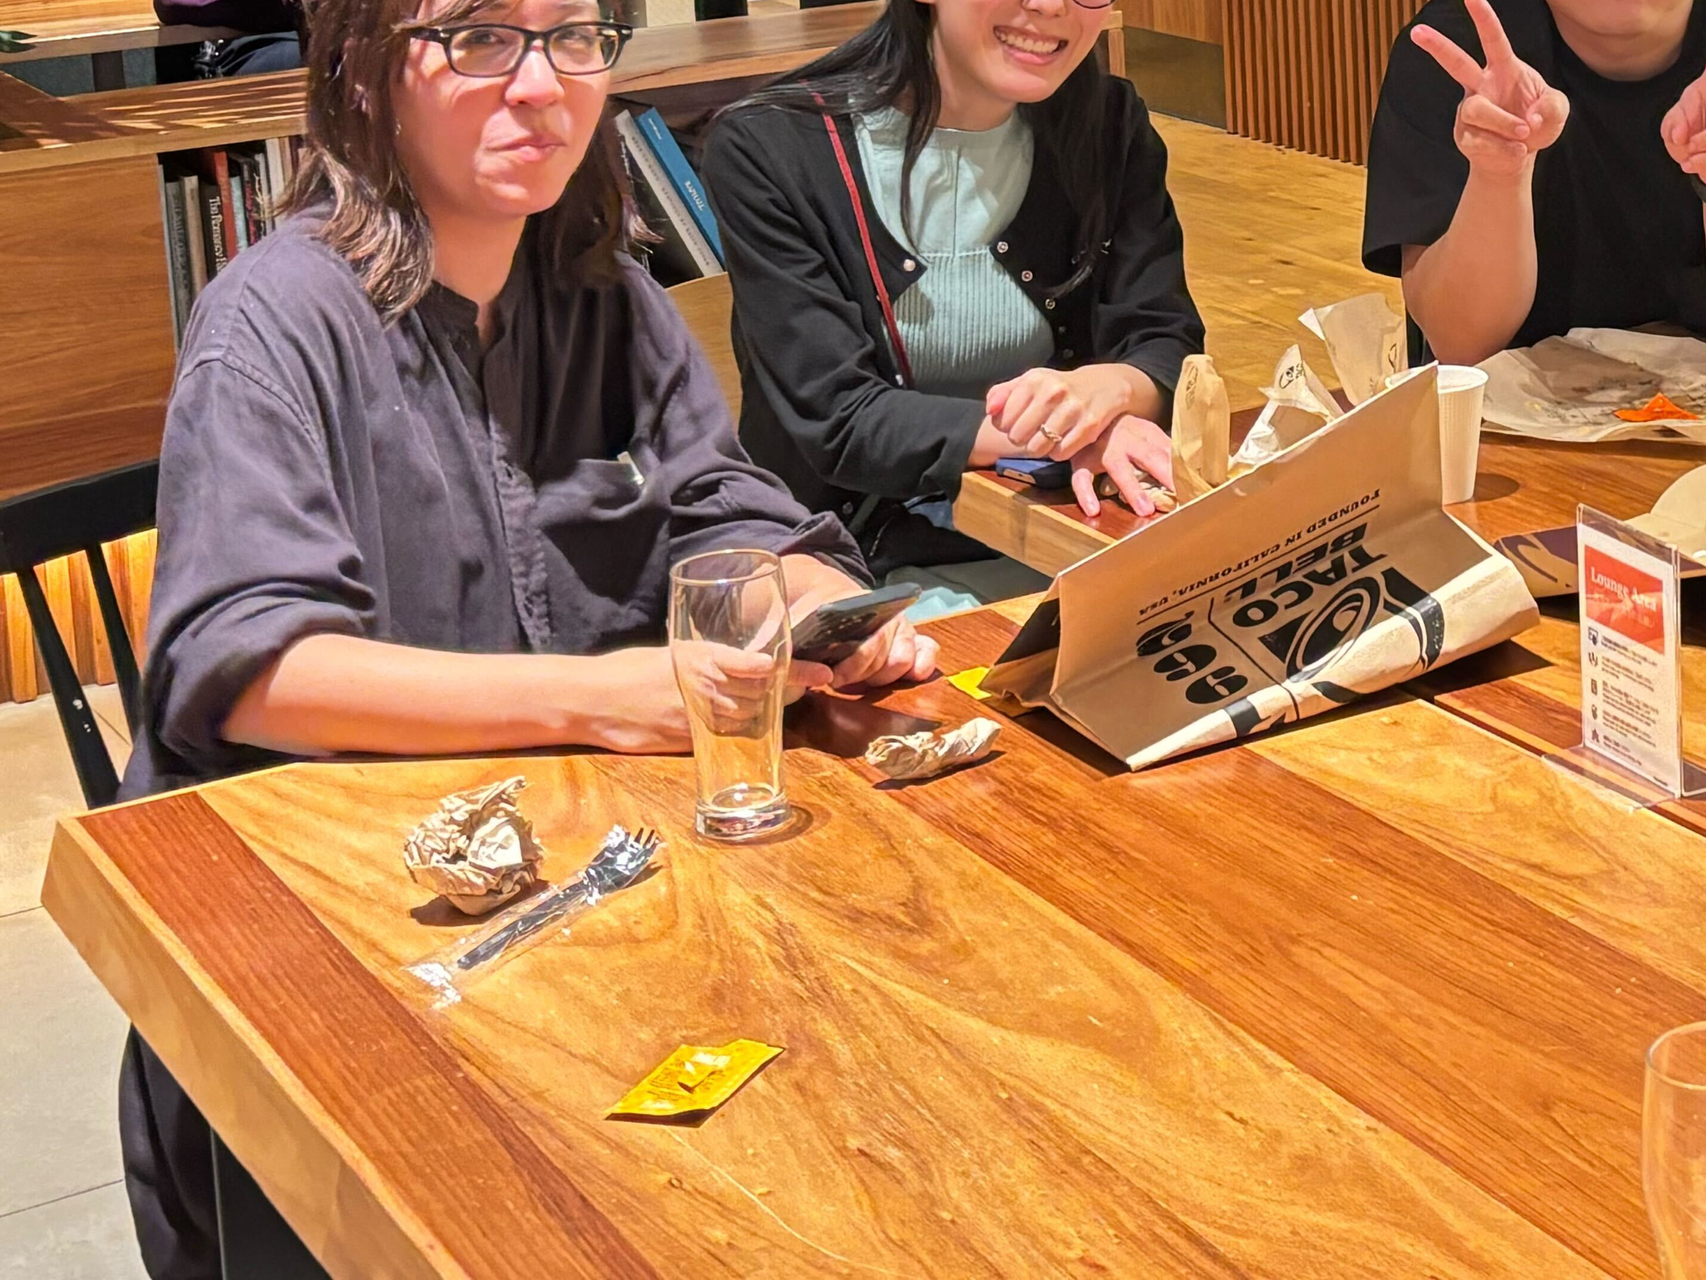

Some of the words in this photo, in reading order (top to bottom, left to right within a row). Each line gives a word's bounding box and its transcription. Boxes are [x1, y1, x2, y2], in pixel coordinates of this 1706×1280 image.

[1306, 488, 1381, 534] FOUNDED
[1225, 522, 1368, 597] BELL
[1284, 531, 1302, 546] IN
[1172, 542, 1281, 597] CALIFORNIA,
[1232, 543, 1387, 629] TACO
[1590, 566, 1629, 600] Lounge
[1631, 587, 1657, 612] Area
[1139, 598, 1169, 615] USA
